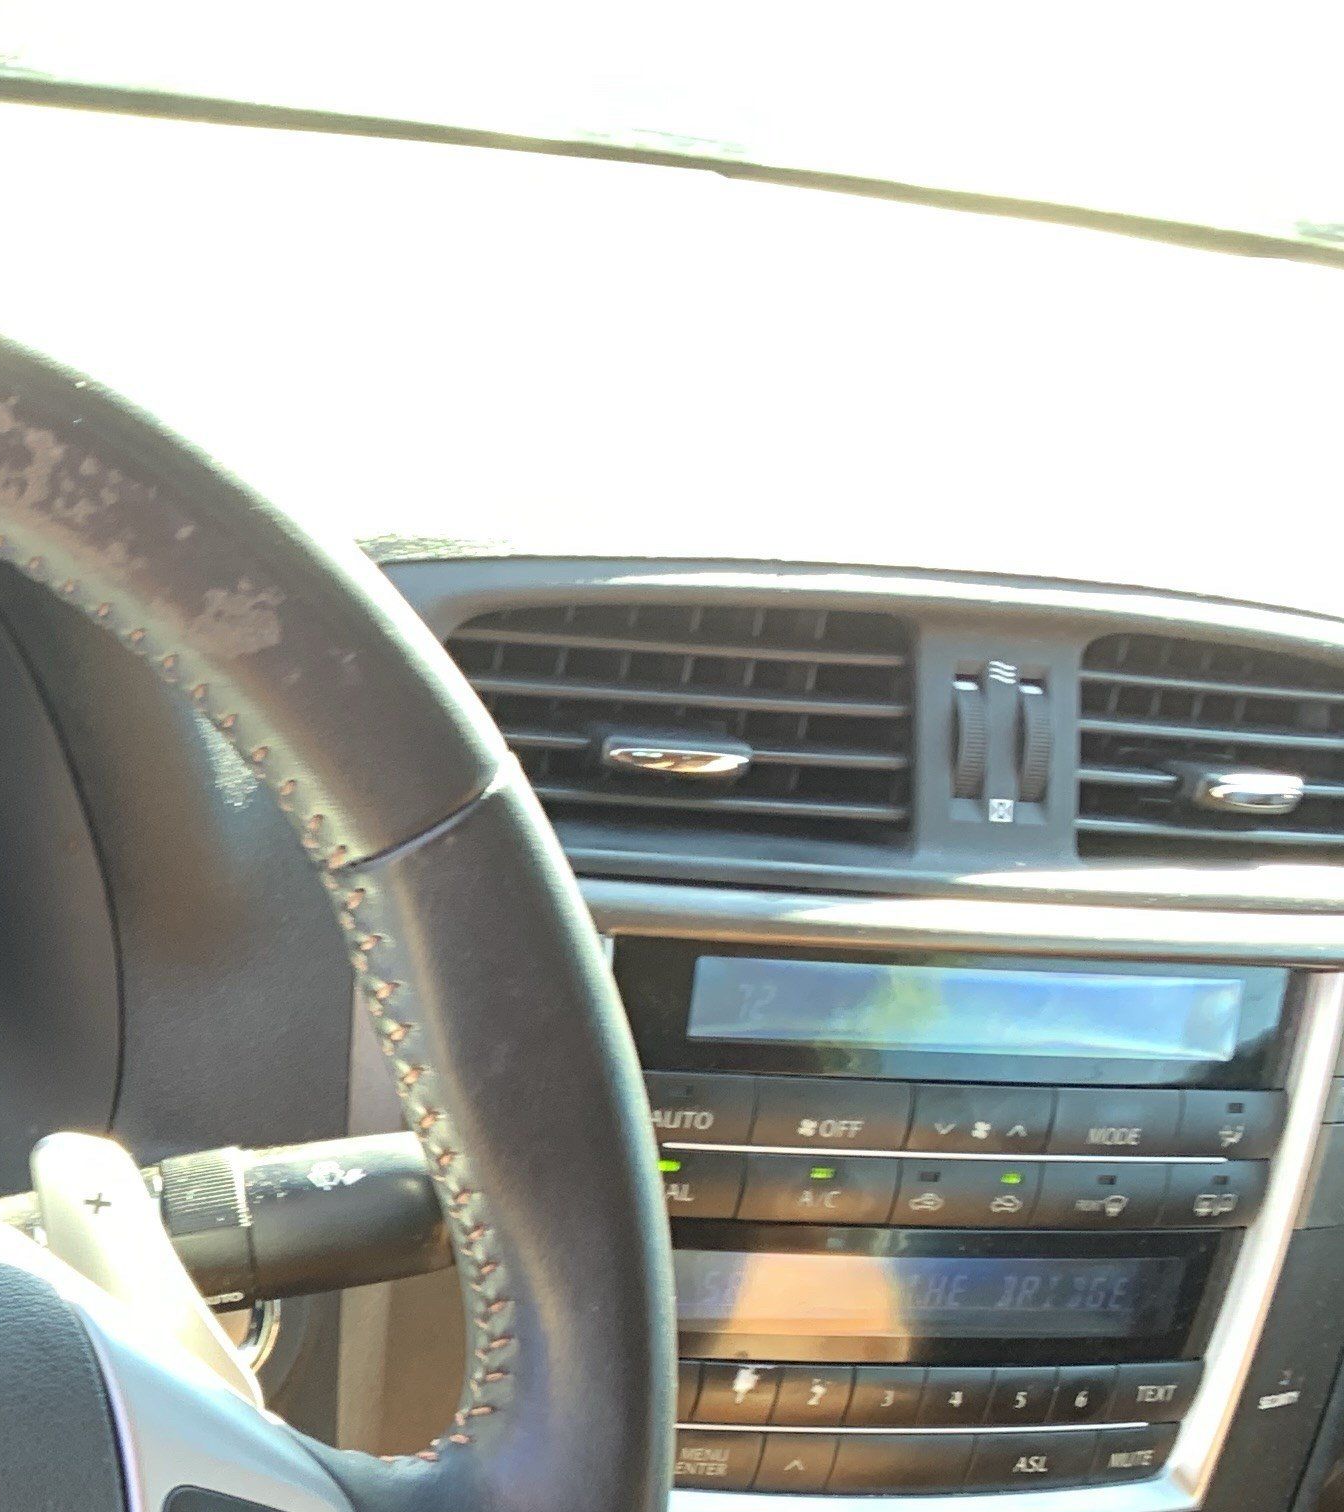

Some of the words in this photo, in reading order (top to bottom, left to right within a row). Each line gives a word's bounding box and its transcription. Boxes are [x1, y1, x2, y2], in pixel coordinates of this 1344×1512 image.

[651, 1109, 714, 1131] AUTO
[818, 1119, 864, 1139] OFF
[1084, 1127, 1142, 1146] MODE
[798, 1190, 842, 1209] A/C
[880, 1390, 895, 1407] 3
[948, 1391, 962, 1408] 4
[1014, 1391, 1028, 1409] 5
[1074, 1390, 1089, 1408] 6
[1136, 1384, 1178, 1402] TEXT
[674, 1461, 728, 1476] ENTER
[1012, 1456, 1049, 1473] ASL
[1107, 1450, 1155, 1469] MUTE
